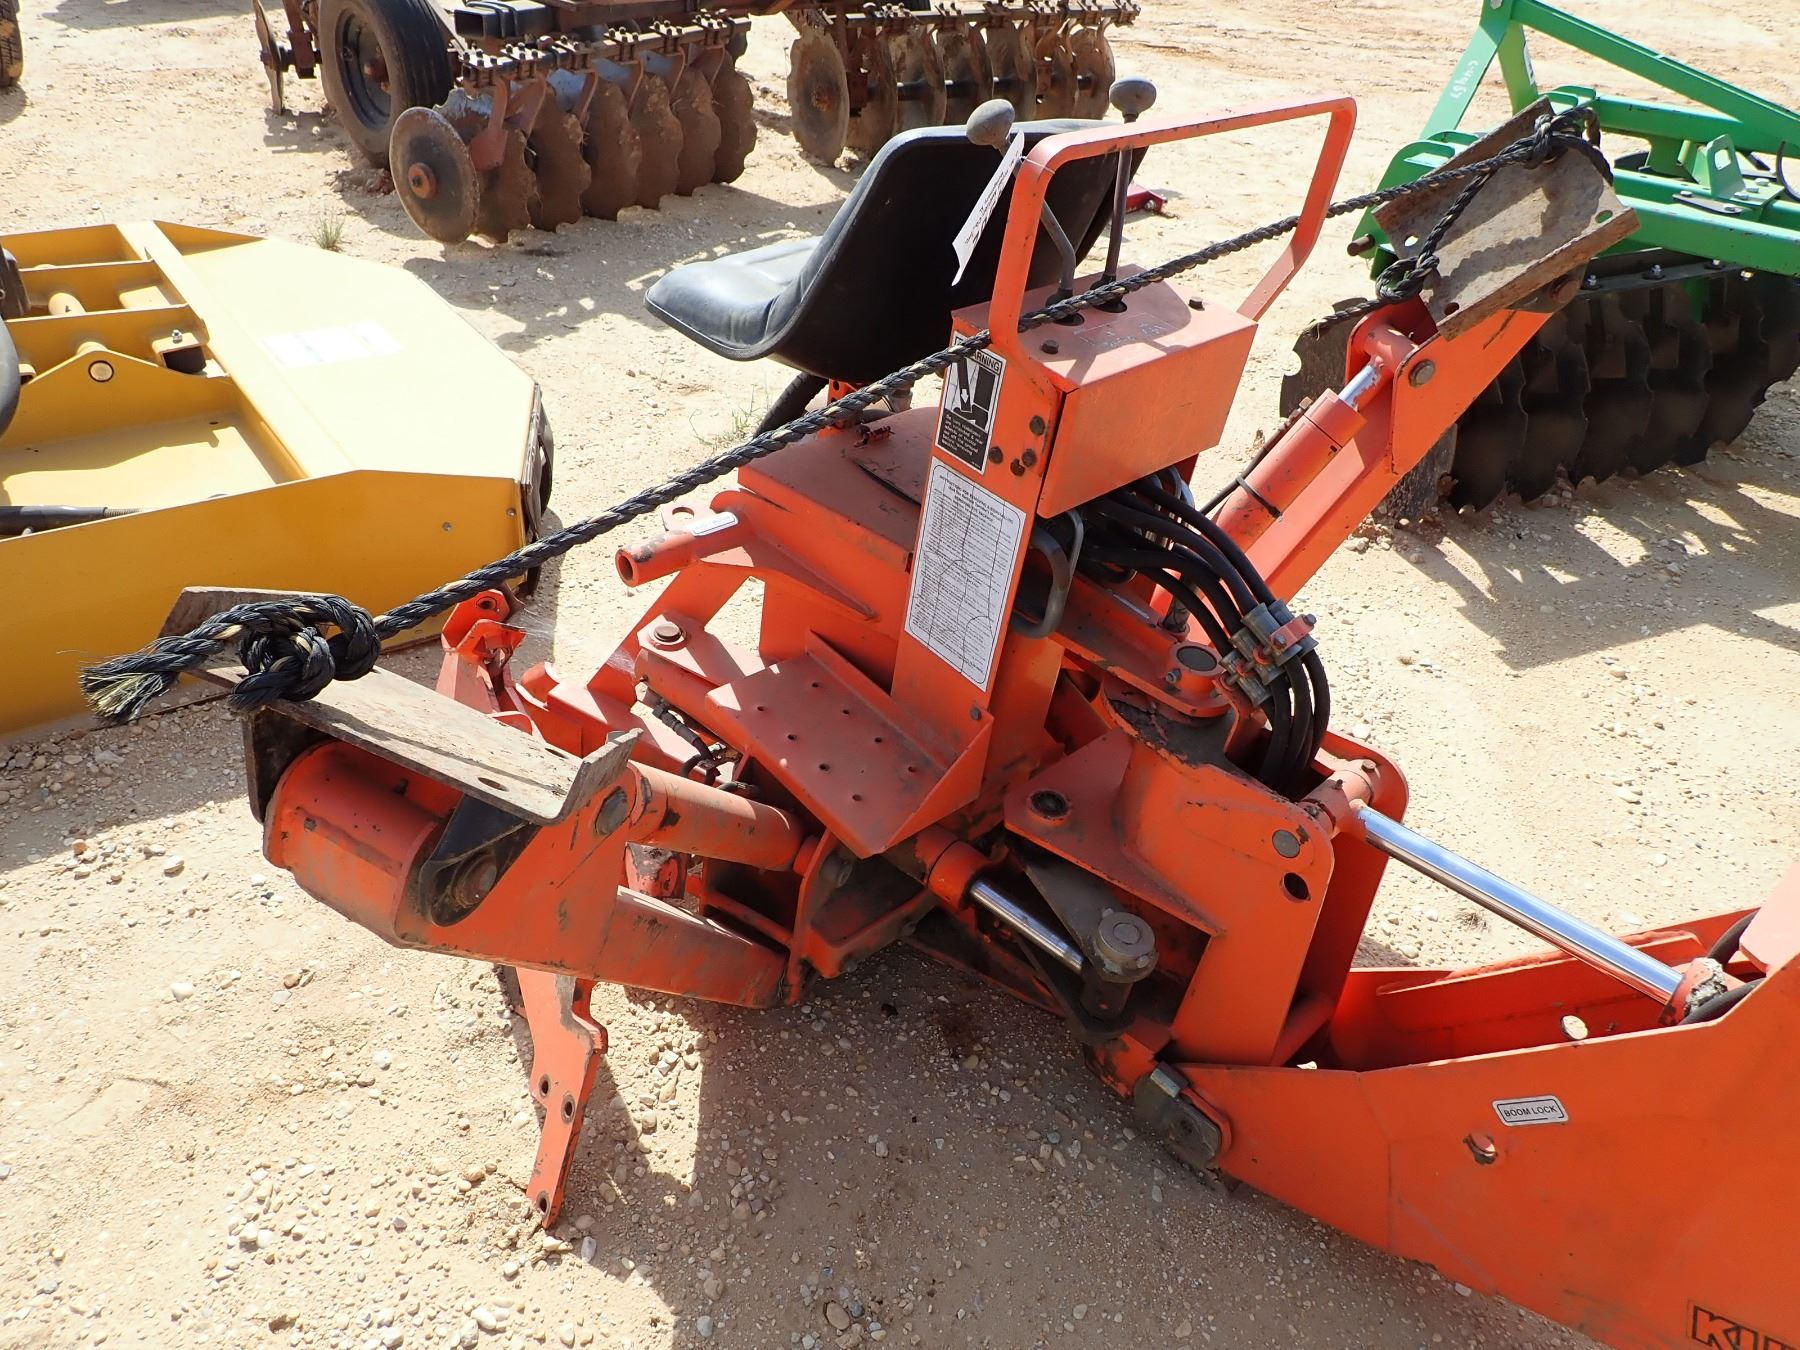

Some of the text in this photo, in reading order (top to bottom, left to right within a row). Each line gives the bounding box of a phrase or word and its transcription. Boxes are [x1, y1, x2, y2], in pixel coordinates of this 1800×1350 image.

[972, 350, 1000, 372] ARNING
[1503, 1106, 1558, 1117] BOOM LOCK
